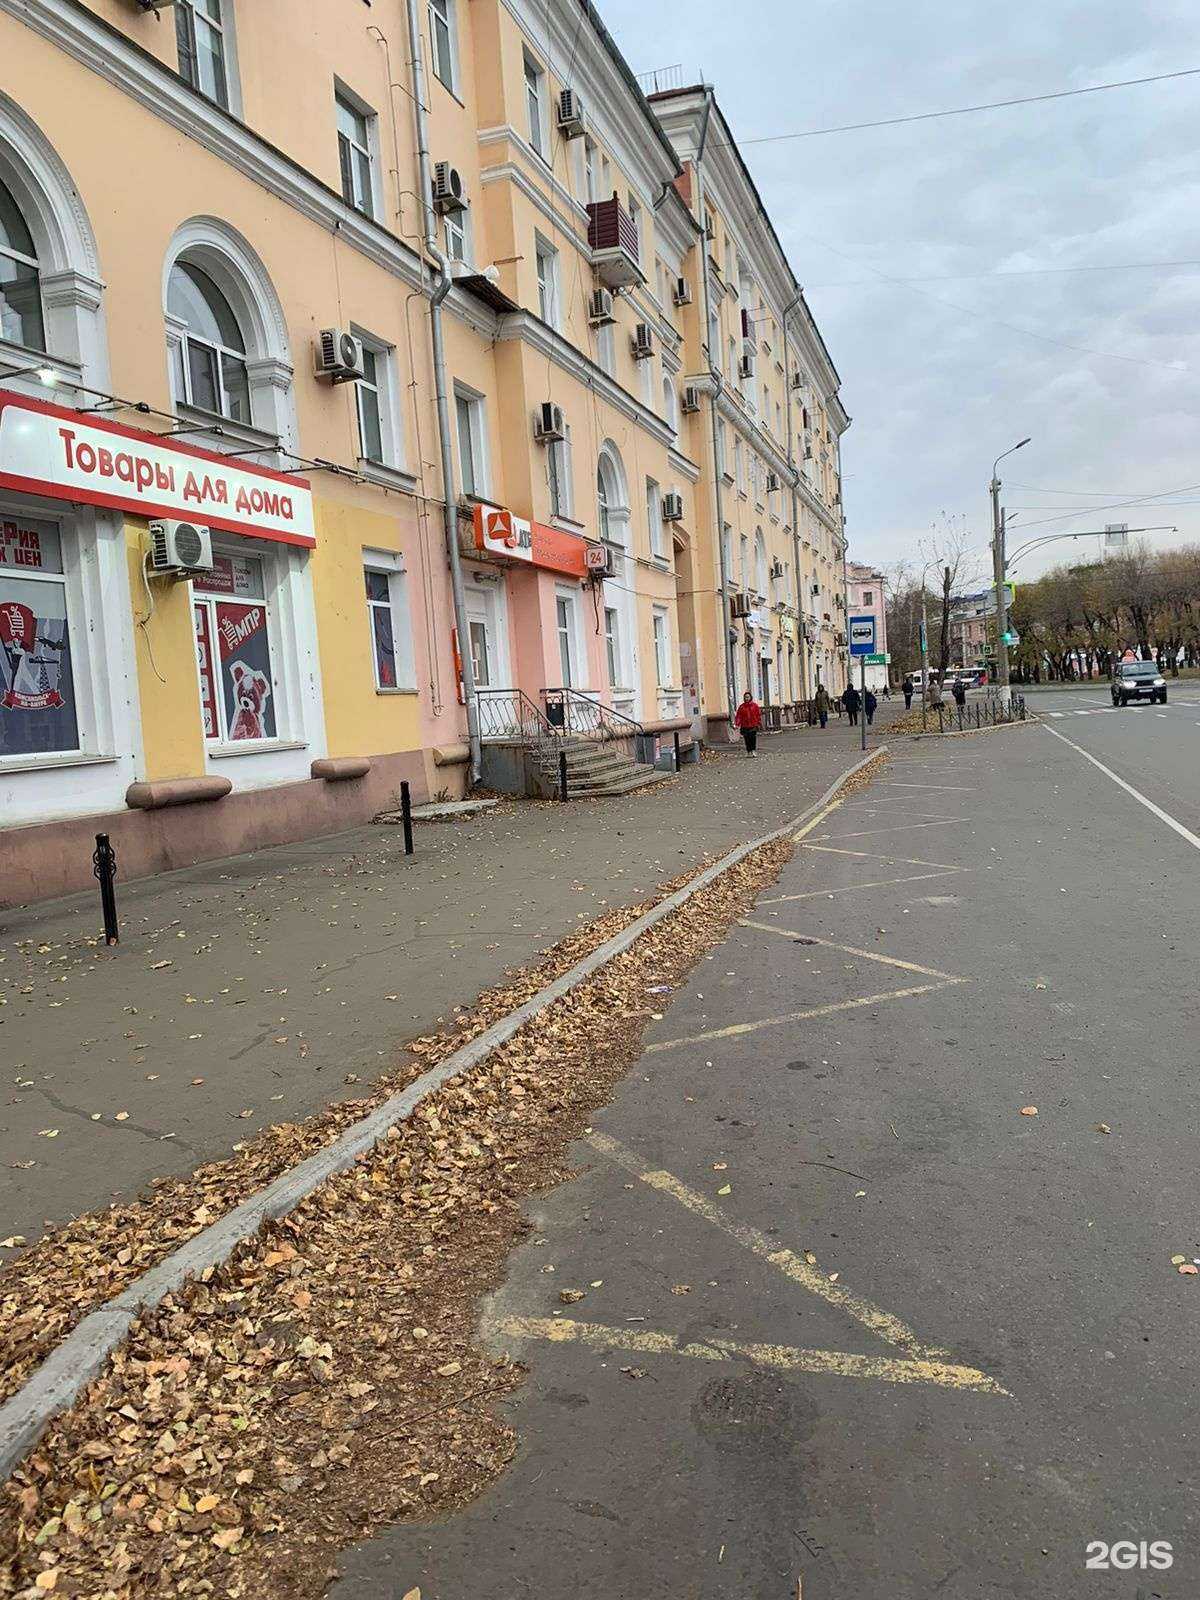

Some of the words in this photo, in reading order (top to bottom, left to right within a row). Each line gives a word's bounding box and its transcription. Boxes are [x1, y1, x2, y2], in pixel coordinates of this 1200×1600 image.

[59, 427, 175, 493] Товары
[183, 471, 229, 503] для
[235, 485, 294, 520] дома
[590, 553, 602, 564] 24
